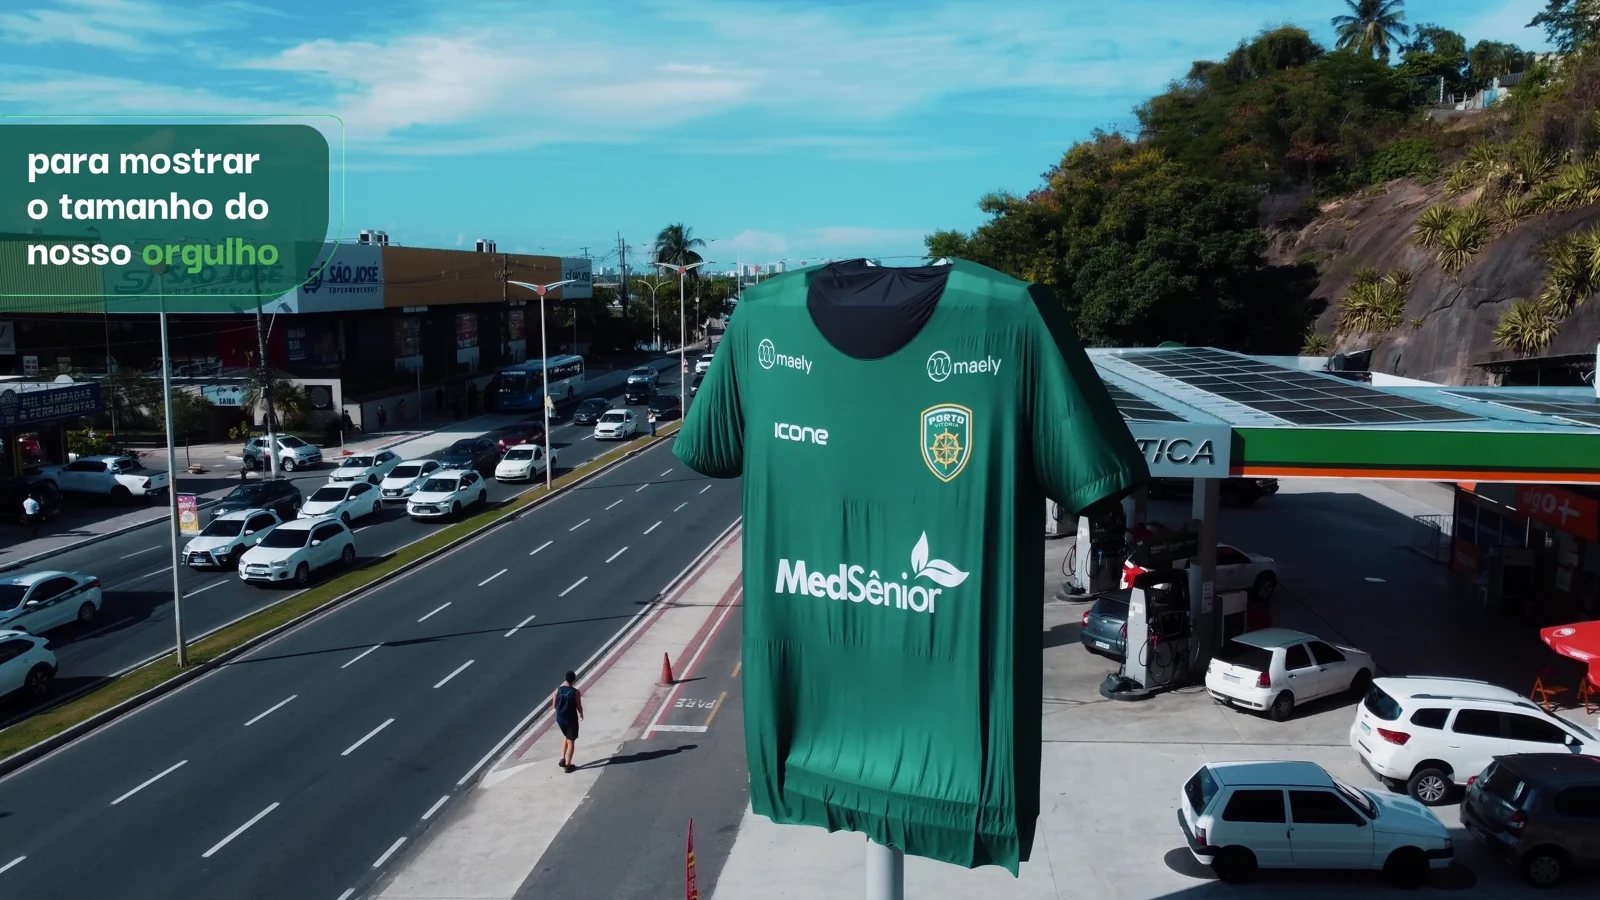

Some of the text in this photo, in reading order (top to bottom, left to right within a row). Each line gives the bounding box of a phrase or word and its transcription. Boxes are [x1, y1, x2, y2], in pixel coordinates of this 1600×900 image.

[353, 261, 379, 283] JOSÉ
[776, 353, 813, 375] maely
[953, 355, 1001, 376] maely
[22, 396, 40, 409] MIL
[30, 400, 96, 419] FERRAMENTAS
[218, 396, 236, 405] SAÍDA
[928, 413, 965, 426] PORTO
[775, 558, 943, 614] MedSênior
[674, 698, 717, 709] PARE
